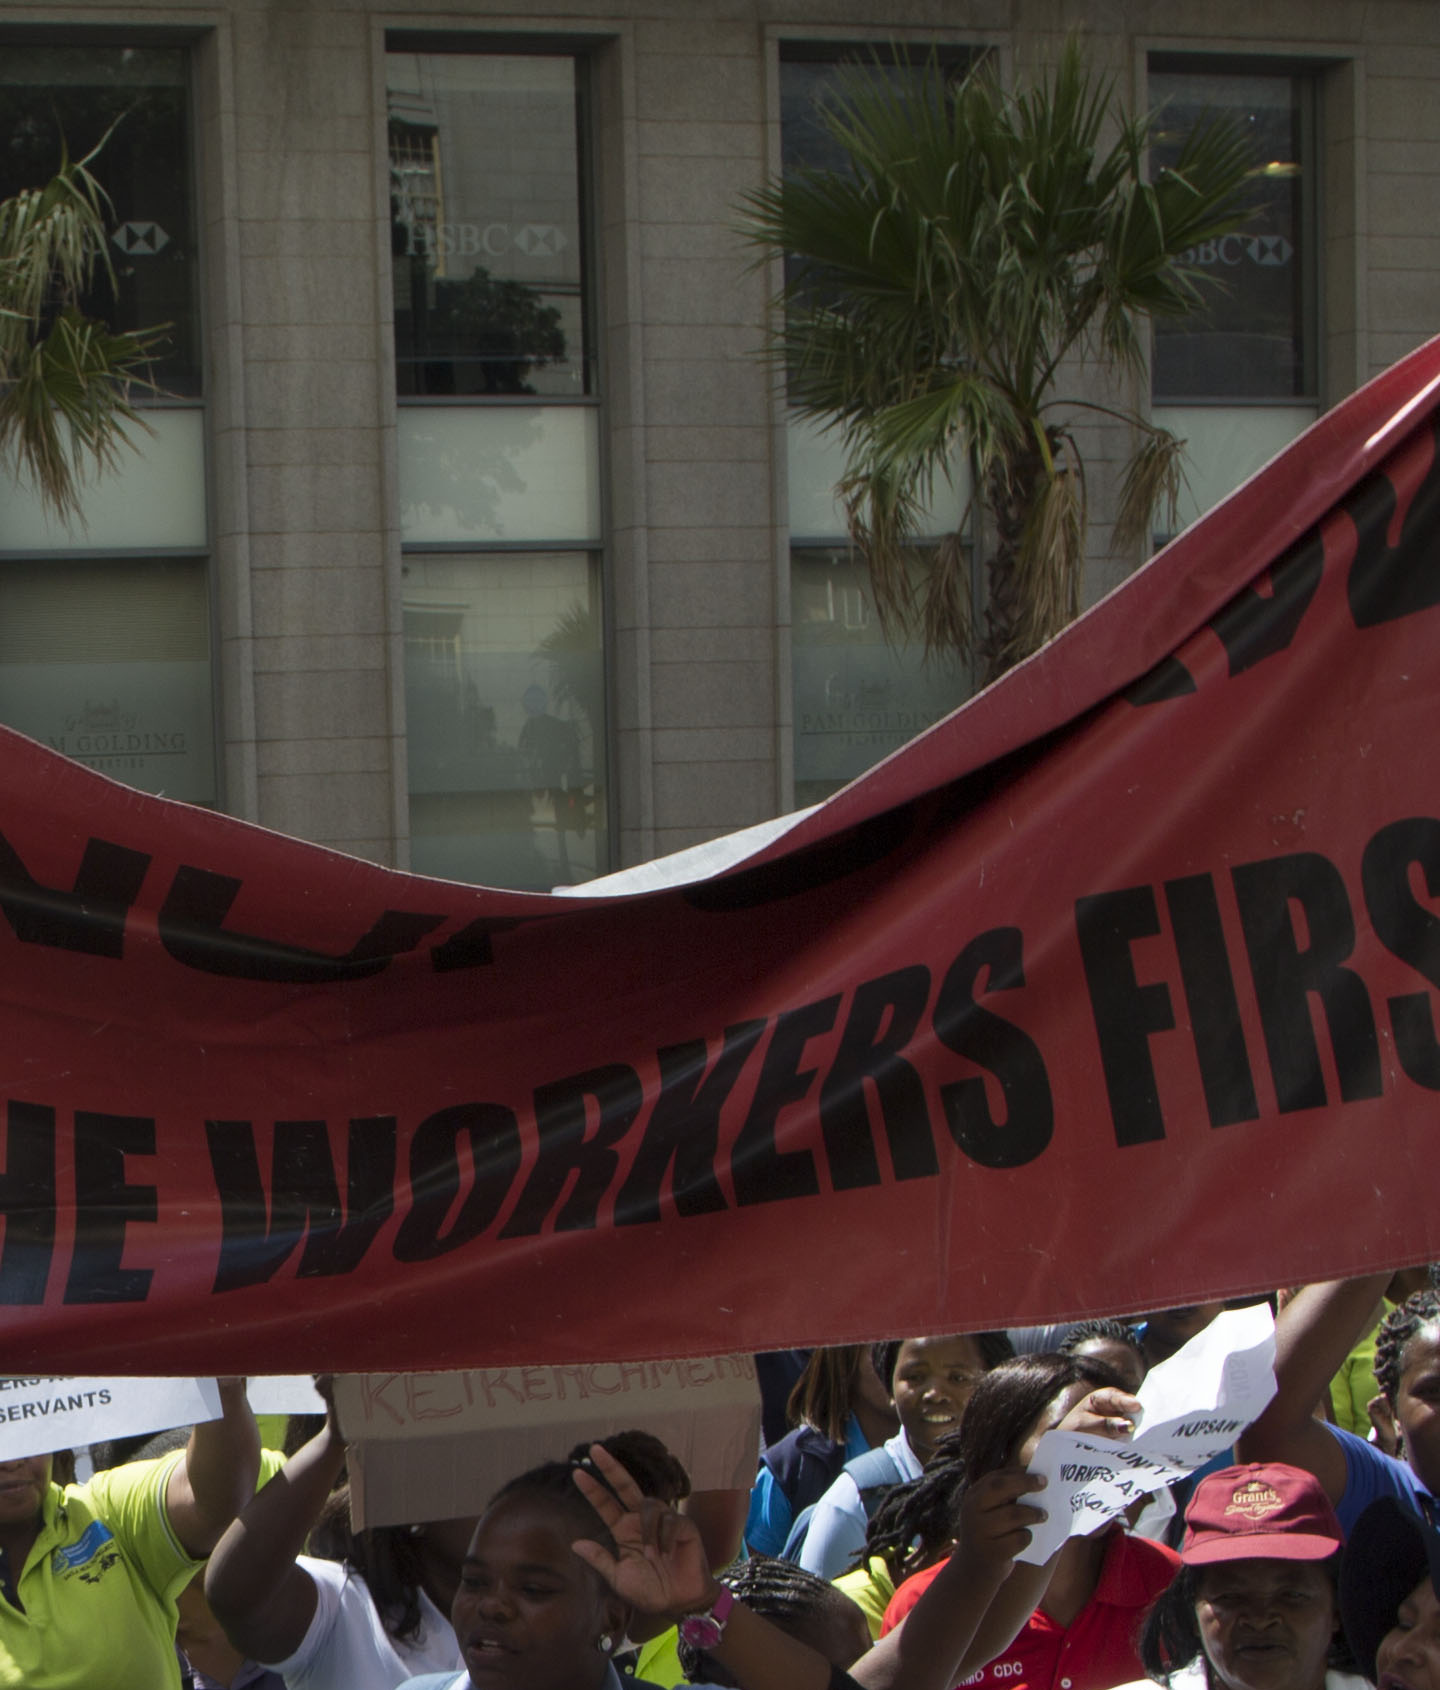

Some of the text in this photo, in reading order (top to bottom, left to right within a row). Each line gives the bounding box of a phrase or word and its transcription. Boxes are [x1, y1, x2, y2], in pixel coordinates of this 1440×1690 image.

[406, 223, 511, 257] HSBC
[76, 734, 185, 752] GOLDING
[205, 926, 1054, 1281] WORKERS
[1232, 1489, 1276, 1504] Grant's
[993, 1662, 1023, 1679] CDC
